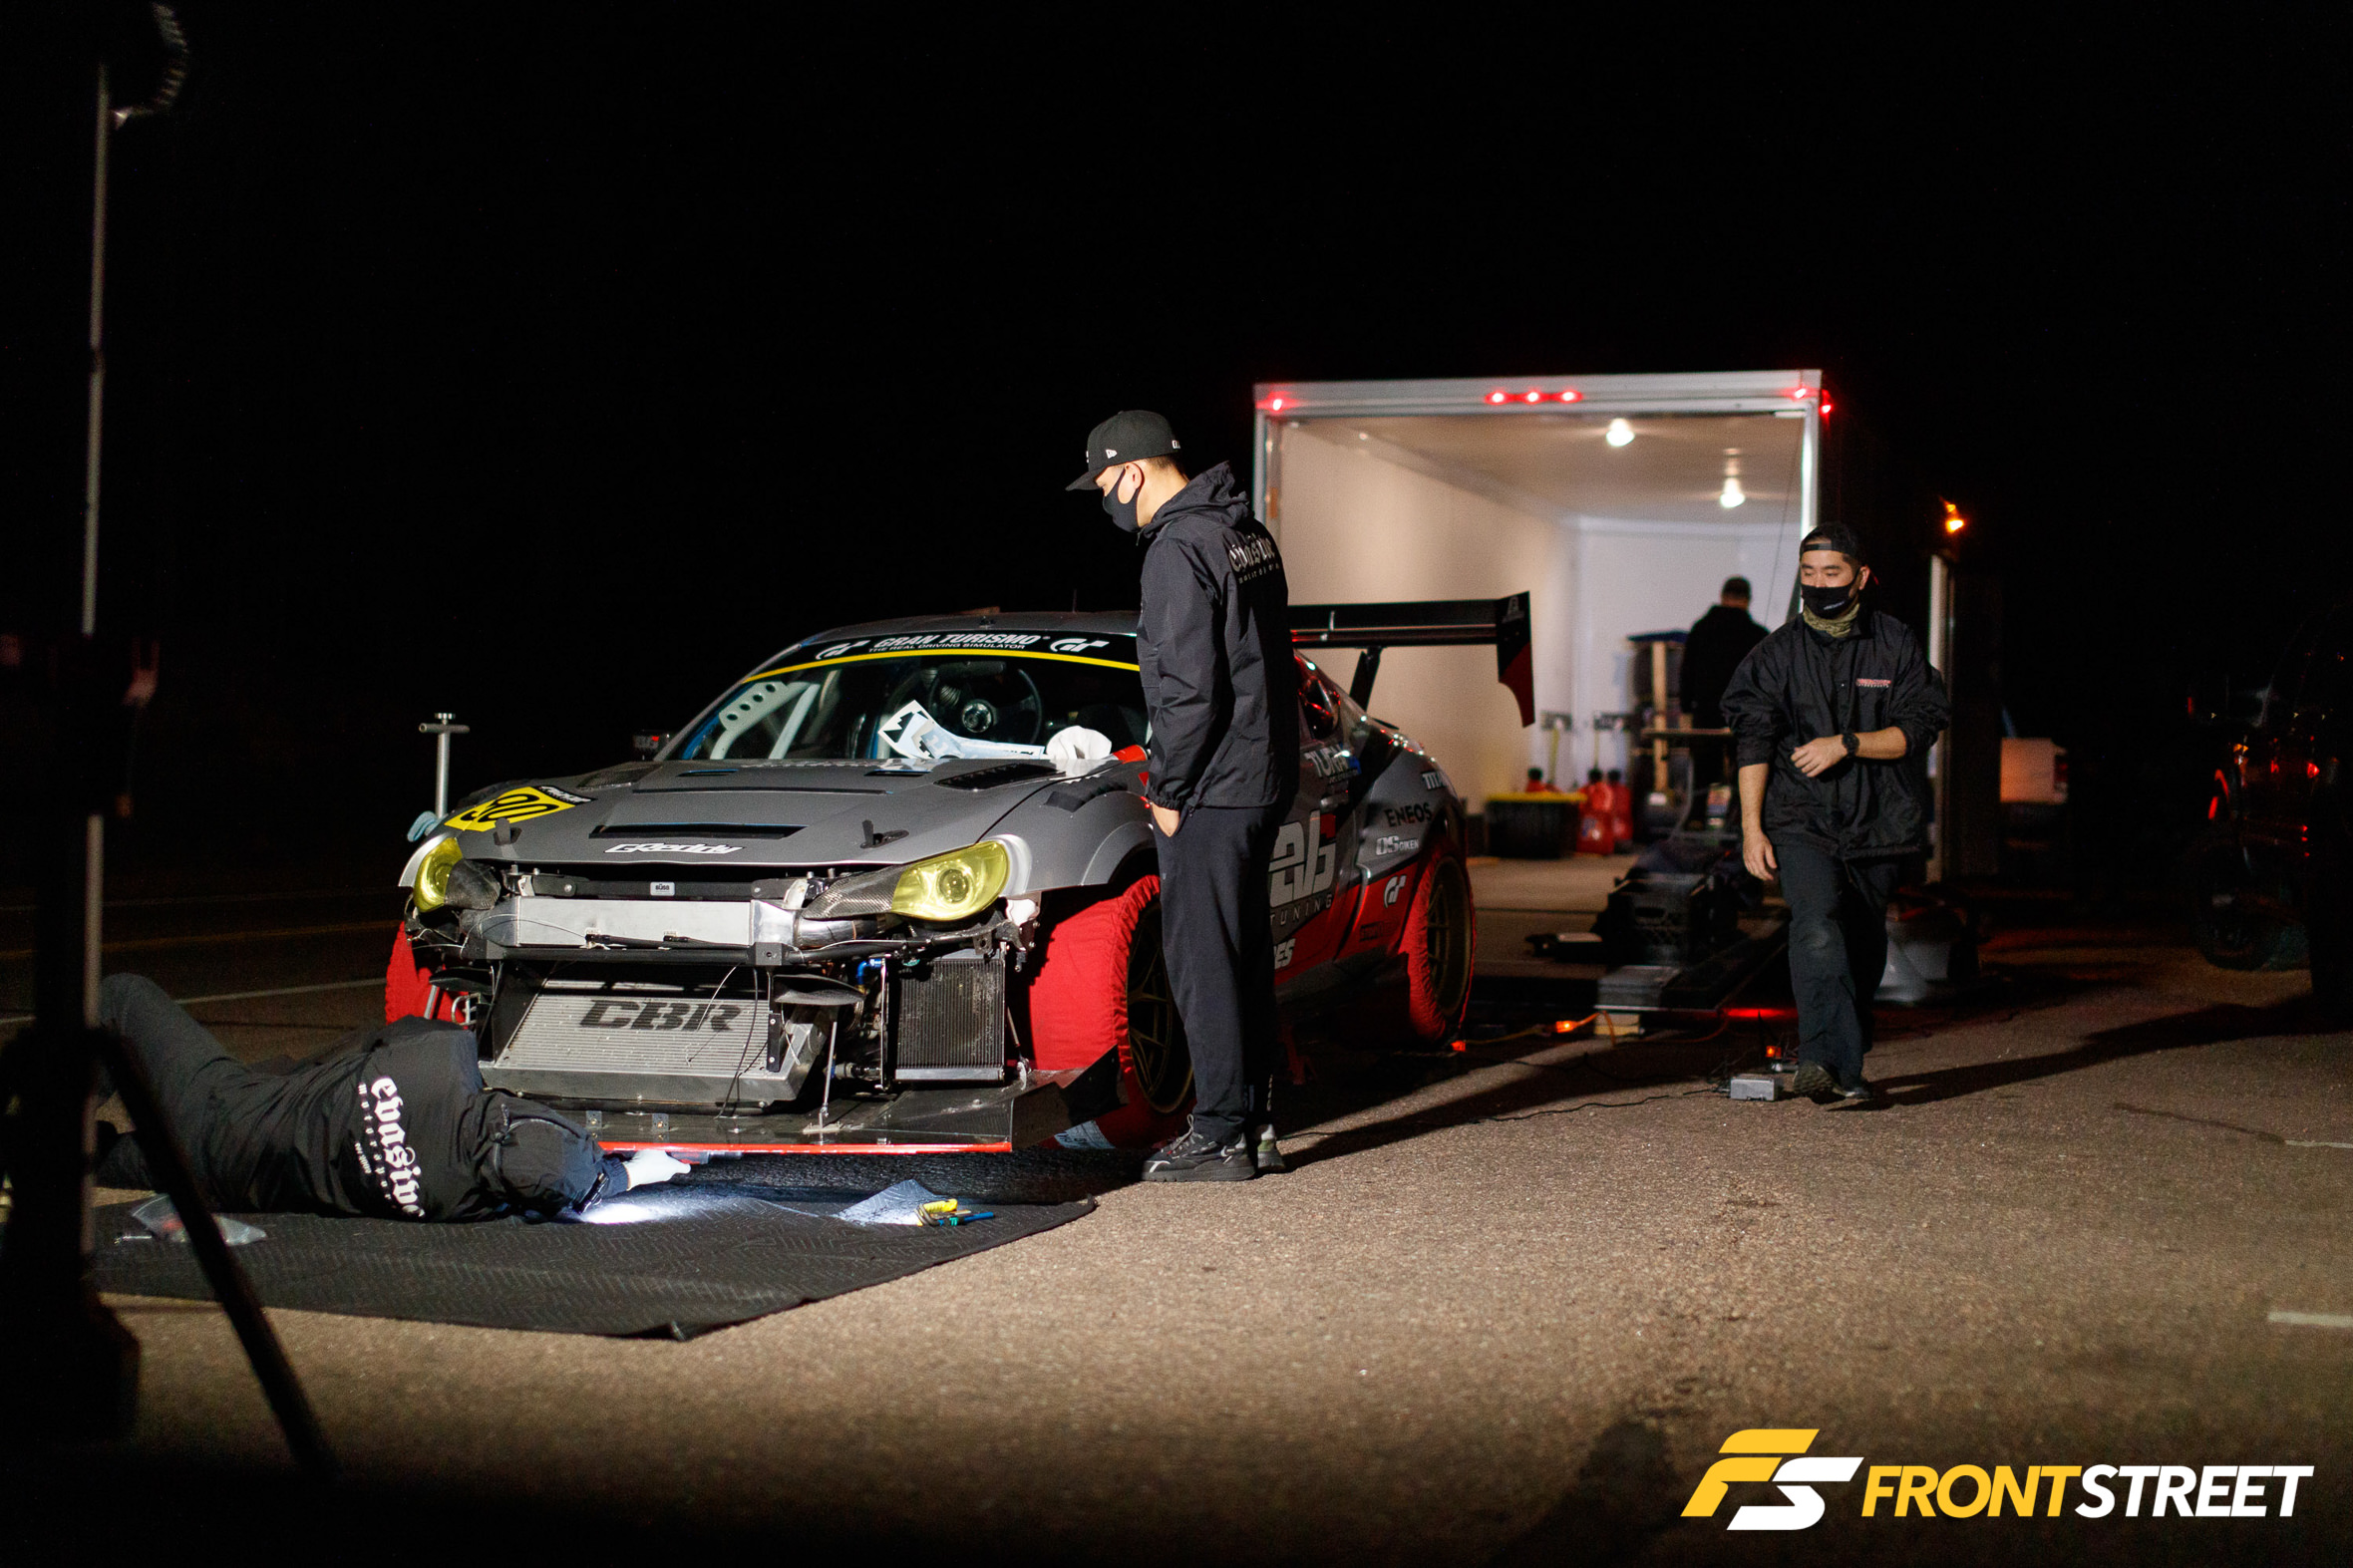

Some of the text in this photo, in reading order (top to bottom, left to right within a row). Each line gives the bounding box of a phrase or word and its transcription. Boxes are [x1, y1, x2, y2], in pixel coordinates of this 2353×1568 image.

[873, 633, 1042, 648] GRAN TURISMO
[1384, 801, 1434, 827] ENEOS
[603, 842, 746, 854] GReddy
[1375, 835, 1400, 856] OS
[1269, 893, 1334, 926] TUNING
[578, 999, 742, 1032] CBR
